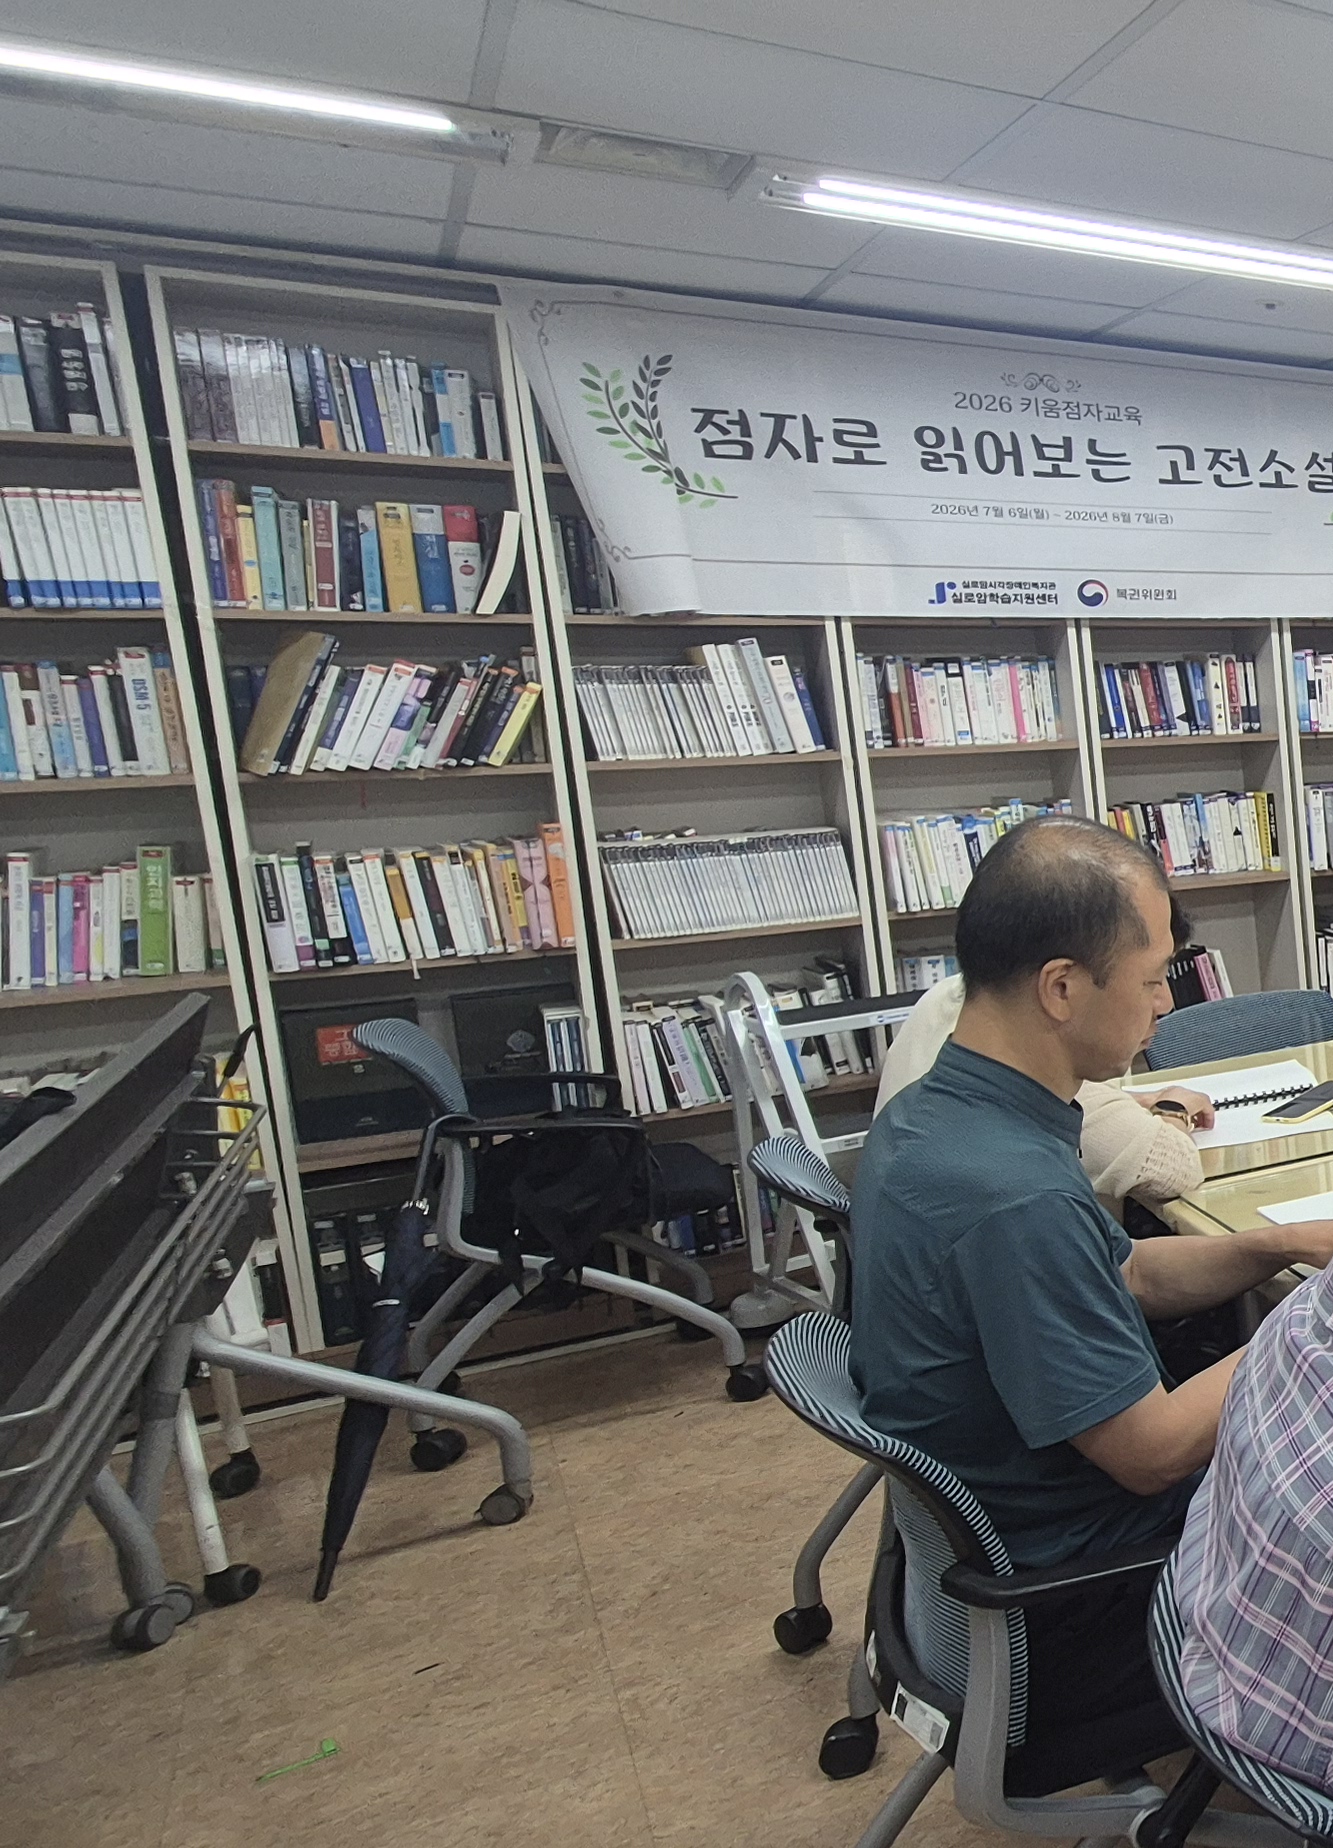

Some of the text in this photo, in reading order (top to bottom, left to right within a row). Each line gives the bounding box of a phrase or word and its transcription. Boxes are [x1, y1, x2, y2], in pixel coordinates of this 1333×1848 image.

[953, 391, 1143, 427] 2026 키움점자교육
[690, 407, 887, 466] 점자로
[913, 425, 1132, 484] 읽어보는
[931, 503, 979, 517] 2026년
[983, 505, 1004, 518] 7월
[1008, 507, 1050, 520] 6일(월)
[1065, 510, 1108, 523] 2026년
[1112, 512, 1131, 523] 8월
[1134, 512, 1174, 525] 7일(금)
[951, 592, 1059, 606] 실로암학습지원센터
